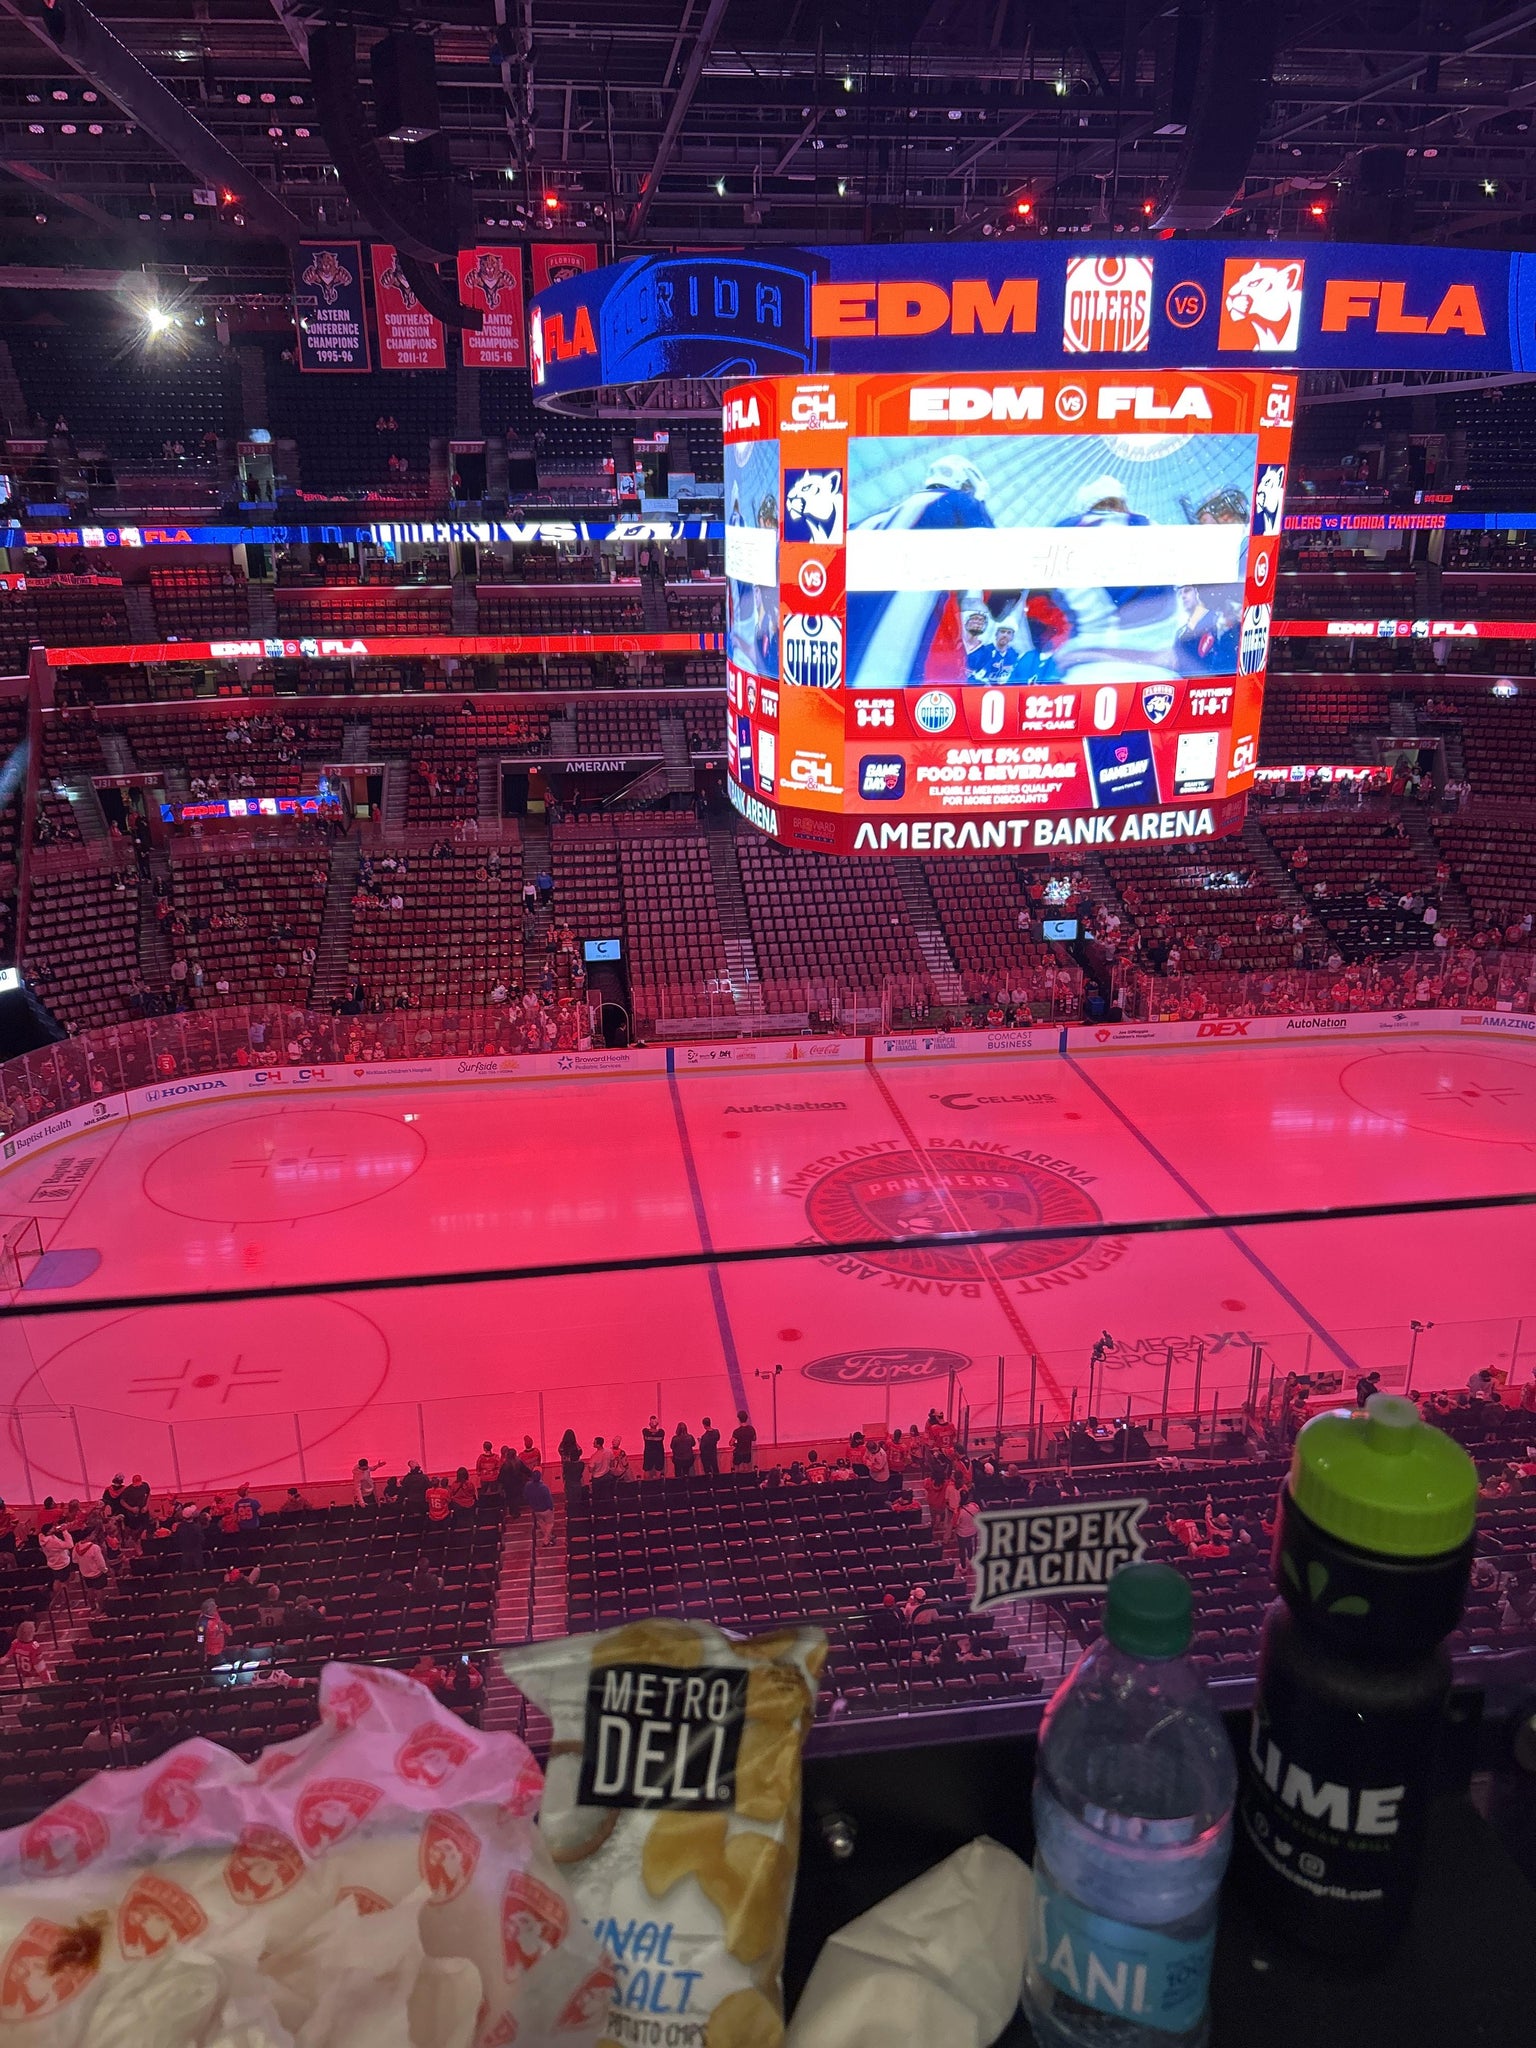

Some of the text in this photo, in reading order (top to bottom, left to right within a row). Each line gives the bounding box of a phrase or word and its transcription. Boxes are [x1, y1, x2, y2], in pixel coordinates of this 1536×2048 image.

[314, 309, 350, 321] ASTERN
[812, 279, 1486, 338] EDM OILERS VS FLA
[385, 313, 434, 325] SOUTHEAST
[482, 313, 513, 325] LANTIC
[305, 323, 359, 335] CONFERENCE
[391, 326, 430, 338] DIVISION
[544, 305, 597, 364] FLA
[307, 337, 359, 349] CHAMPIONS
[386, 338, 437, 350] CHAMPIONS
[469, 337, 519, 349] CHAMPIONS
[316, 351, 353, 363] 1995-96
[397, 351, 428, 363] 2011-12
[480, 351, 513, 362] 2015-16
[791, 393, 836, 421] CH
[909, 386, 1213, 421] EDM VS FLA
[1267, 392, 1291, 418] CH
[731, 396, 760, 430] FLA
[1284, 516, 1321, 529] OILERS
[1340, 516, 1384, 530] FLORIDA
[1388, 515, 1445, 529] PANTHERS
[25, 532, 78, 544] EDM
[145, 530, 192, 543] FLA
[503, 522, 579, 541] VS
[804, 572, 821, 586] VS
[1327, 623, 1374, 635] EDM
[1432, 623, 1478, 635] FLA
[322, 641, 368, 654] FLA
[786, 637, 838, 674] OILERS
[1189, 687, 1233, 698] PANTHERS
[981, 690, 1005, 734] 0
[1094, 687, 1118, 730] 0
[946, 749, 993, 764] SAVE
[1022, 747, 1049, 762] ON
[565, 760, 627, 773] AMERANT
[791, 759, 832, 785] CH
[866, 764, 901, 777] GAME
[917, 763, 1076, 782] FOOD & BEVERAGE
[144, 776, 158, 785] 132
[863, 777, 886, 790] DAY
[1021, 782, 1063, 794] QUALIFY
[964, 795, 993, 805] MORE
[993, 793, 1048, 805] DISCOUNTS
[182, 804, 225, 817] EDM
[745, 795, 778, 836] ARENA
[854, 819, 1030, 849] AMERANT
[1034, 815, 1117, 846] BANK
[1120, 808, 1214, 842] ARENA
[1196, 1020, 1252, 1038] DEX
[1287, 1016, 1347, 1029] AutoNation
[1482, 1017, 1536, 1030] AMAZING
[988, 1031, 1032, 1041] COMCAST
[988, 1040, 1032, 1050] BUSINESS
[299, 1069, 325, 1080] CH
[458, 1061, 498, 1074] Surfside
[255, 1071, 281, 1082] CH
[162, 1080, 227, 1097] HONDA
[976, 1094, 1056, 1104] CELSIUS
[724, 1100, 848, 1116] AutoNation
[16, 1119, 72, 1150] Baptist Health
[42, 1158, 75, 1184] Baptist
[65, 1157, 96, 1183] Health
[781, 1137, 1098, 1199] AMERANT BANK ARENA
[869, 1175, 1009, 1196] PANTHERS
[881, 1233, 1135, 1299] BANK MERANT
[1102, 1346, 1211, 1371] SPORT
[838, 1353, 938, 1380] Ford
[430, 1498, 442, 1510] 16
[988, 1509, 1133, 1558] RISPEK
[986, 1547, 1130, 1598] RACING
[602, 1670, 730, 1723] METRO
[592, 1716, 726, 1800] DELI
[606, 2012, 663, 2045] POTATO
